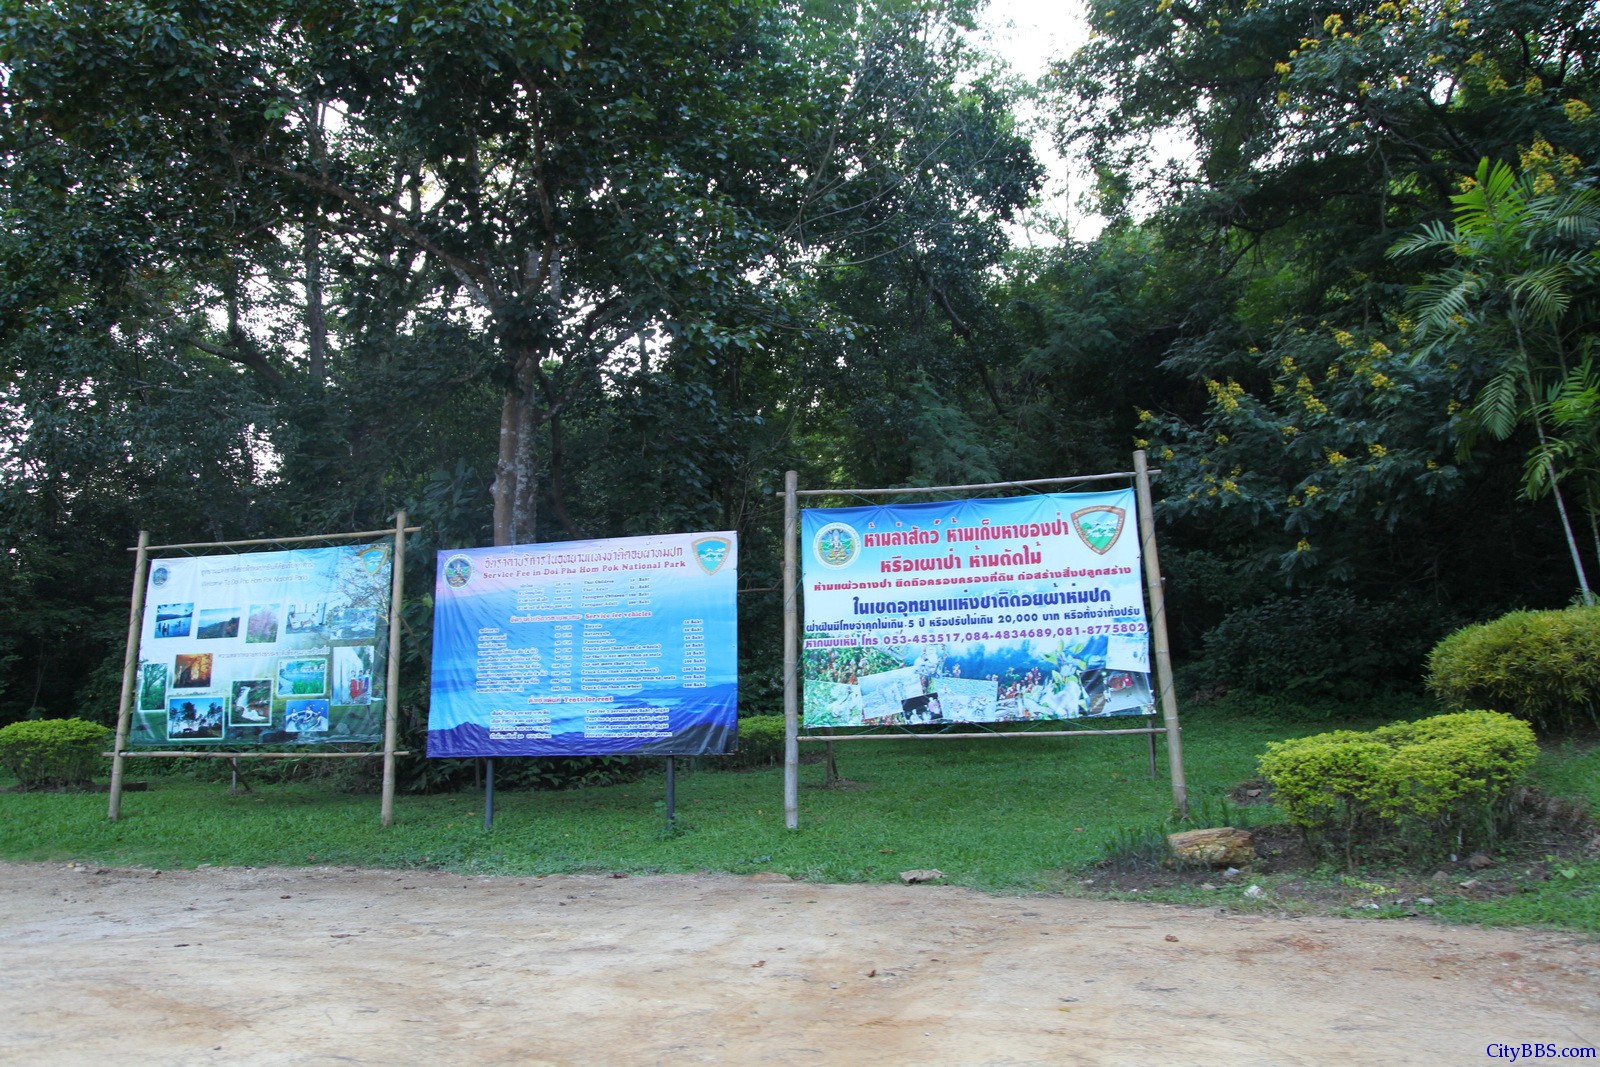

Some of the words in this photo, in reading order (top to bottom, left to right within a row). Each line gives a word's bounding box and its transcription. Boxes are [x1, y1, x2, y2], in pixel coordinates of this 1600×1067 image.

[864, 519, 941, 548] ห้ามล่าสัตว์
[946, 512, 1069, 543] ห้ามเก็บหาของป่า
[881, 548, 962, 573] หรือเผาป่า
[969, 542, 1042, 568] ห้ามตัดไม้
[483, 570, 514, 579] Service
[516, 569, 530, 578] Fee
[533, 569, 541, 577] in
[544, 567, 558, 576] Doi
[561, 566, 577, 576] Pha
[580, 565, 599, 574] Hom
[602, 564, 619, 572] Pok
[622, 561, 661, 571] National
[664, 559, 686, 569] Park
[1018, 565, 1132, 581] ก่อสร้างสิ่งปลูกสร้าง
[852, 583, 1111, 617] ในเขตอุทยานแห่งชาติดอยผ้าห่มปก
[908, 620, 915, 628] 5
[918, 617, 925, 628] ปี
[998, 613, 1038, 625] 20,000
[1042, 612, 1060, 622] บาท
[805, 634, 857, 649] หากพบเห็น
[861, 634, 879, 646] โทร
